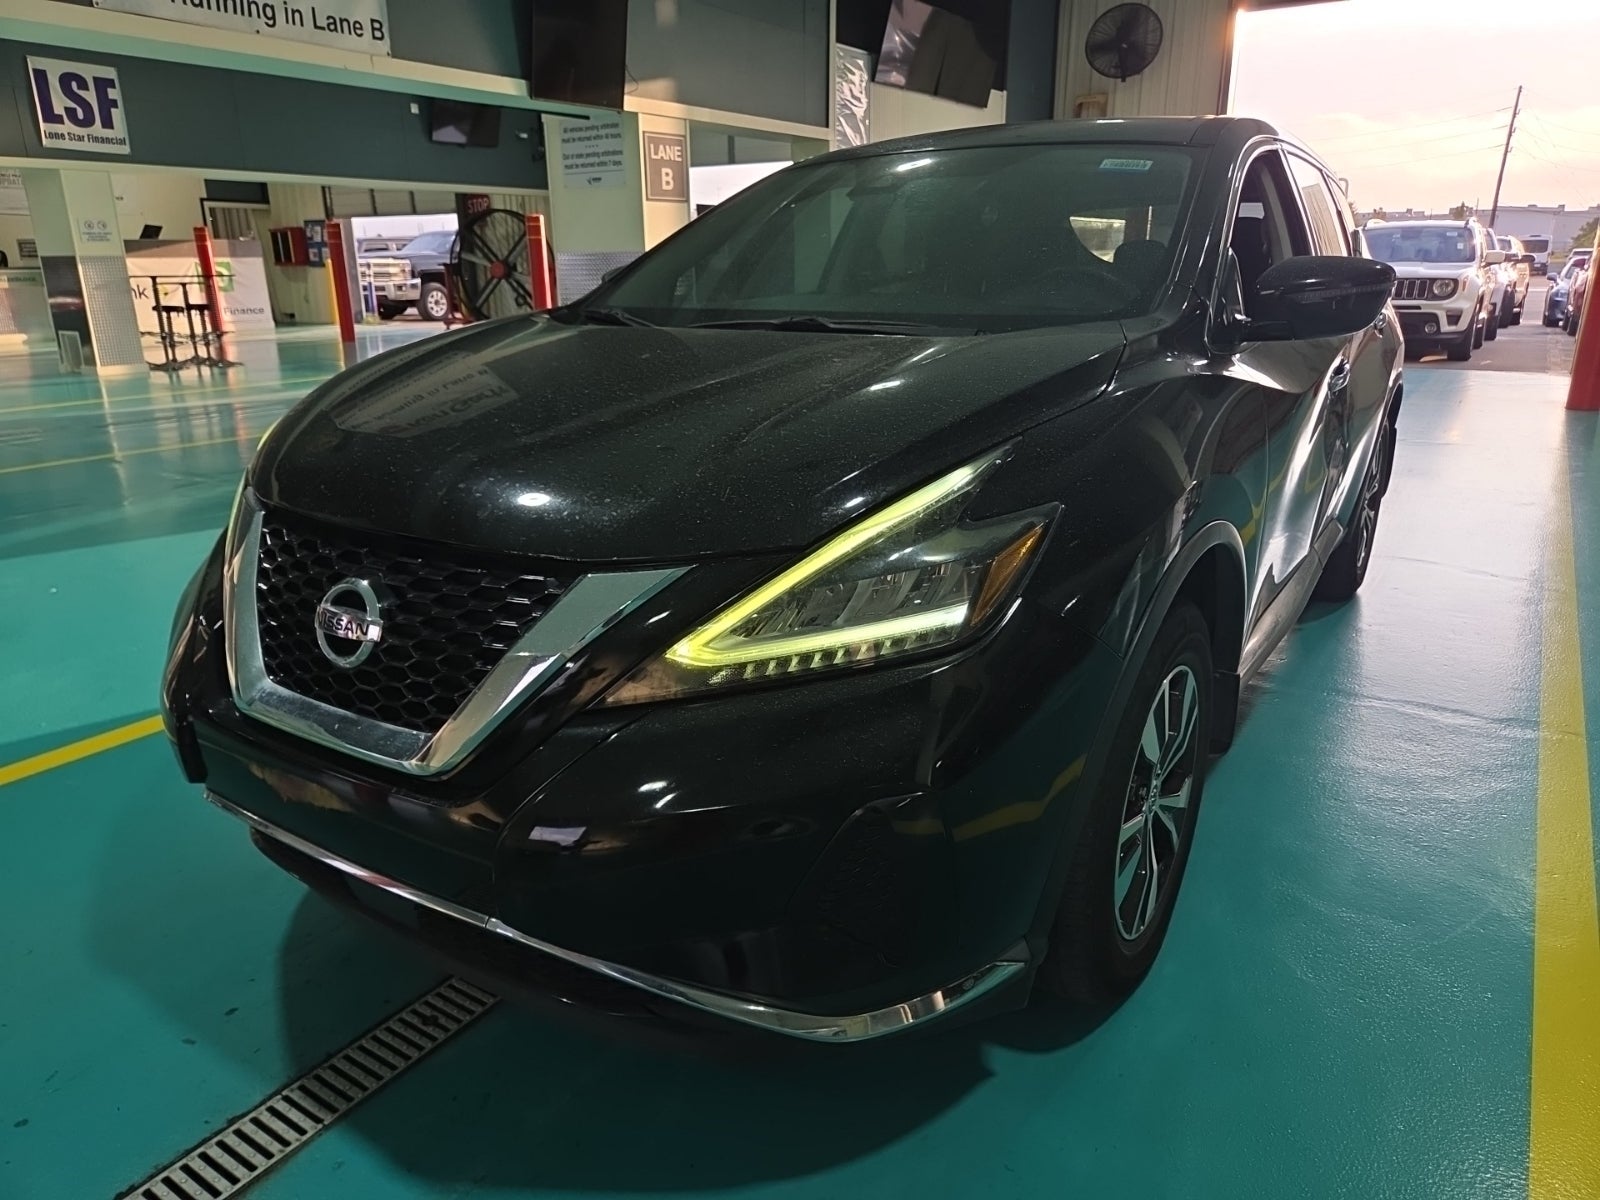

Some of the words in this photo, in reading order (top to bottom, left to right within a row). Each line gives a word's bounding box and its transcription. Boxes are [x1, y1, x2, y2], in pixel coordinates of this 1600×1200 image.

[171, 0, 277, 28] unning
[283, 1, 304, 28] in
[311, 6, 365, 38] Lane
[370, 18, 385, 42] B
[32, 67, 119, 130] LSF
[43, 129, 66, 141] Lone
[67, 131, 86, 143] Star
[87, 133, 128, 146] Financial
[650, 143, 682, 162] LANE
[661, 167, 674, 190] B
[468, 197, 489, 213] STOP
[223, 305, 265, 316] Finance
[319, 608, 370, 637] NISSAN
